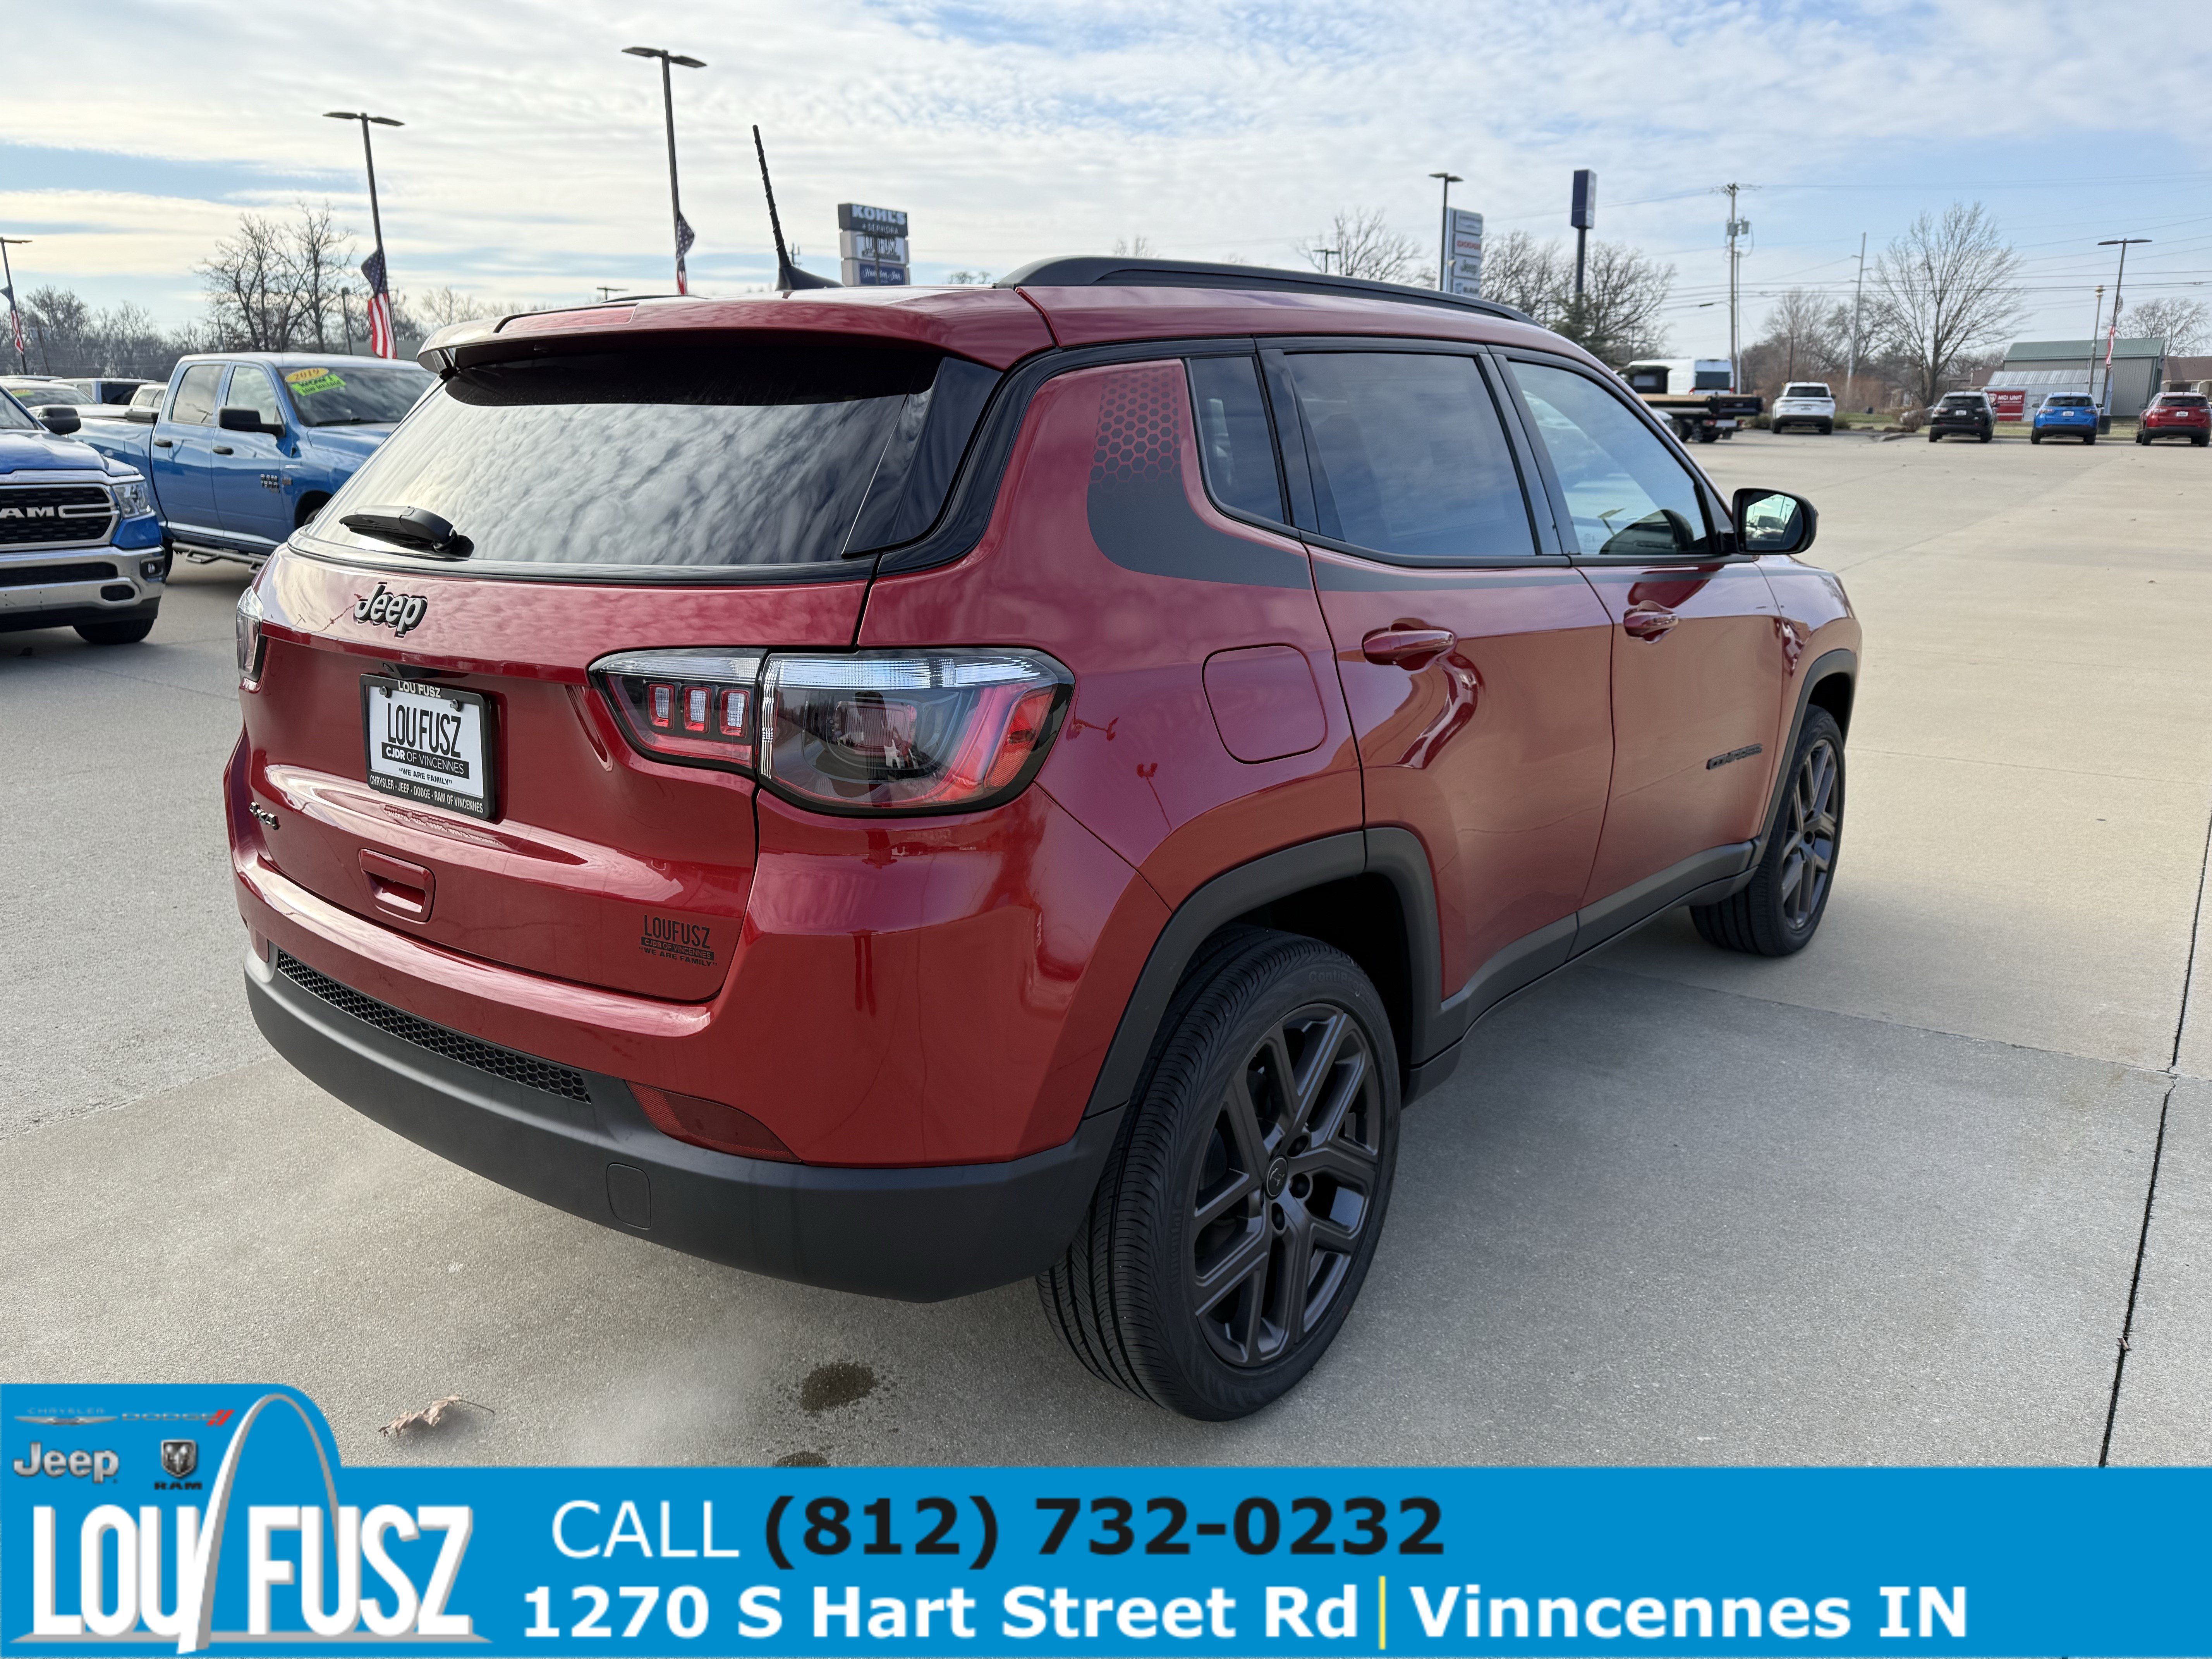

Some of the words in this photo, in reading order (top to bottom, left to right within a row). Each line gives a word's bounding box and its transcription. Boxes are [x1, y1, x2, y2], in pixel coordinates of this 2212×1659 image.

[852, 205, 906, 225] KOHL'S
[295, 368, 319, 381] 2019
[354, 582, 428, 638] Jeep
[398, 680, 416, 694] LOU
[418, 684, 441, 698] FUSZ
[386, 747, 405, 760] CJDR
[407, 751, 417, 762] OF
[419, 754, 464, 774] VINCENNES
[370, 775, 394, 790] CHRYSLER
[398, 782, 410, 793] JEEP
[414, 786, 430, 799] DODGE
[434, 791, 446, 803] RAM
[447, 795, 453, 805] OF
[454, 797, 483, 813] VINCENNES
[645, 939, 662, 948] CJDR
[673, 945, 711, 958] VINCENNES
[659, 951, 677, 960] ARE
